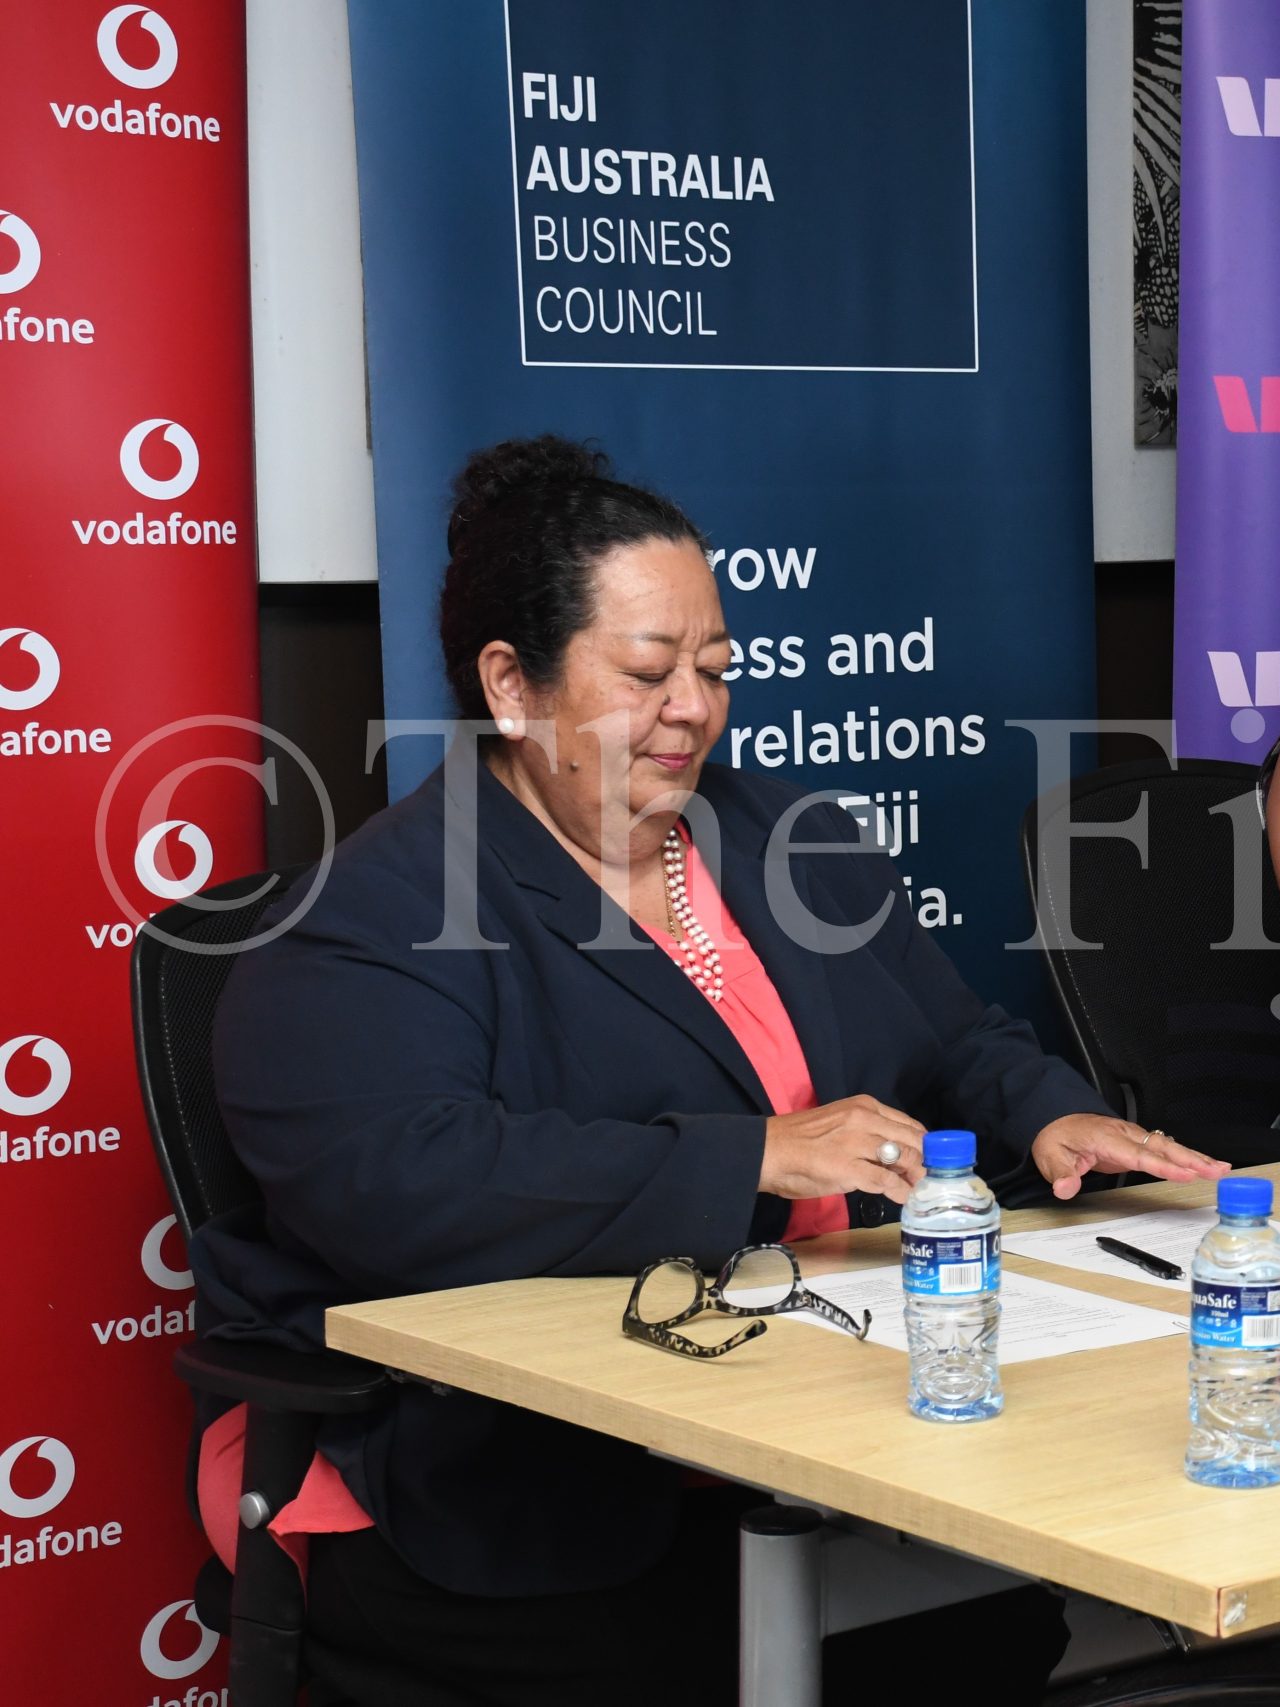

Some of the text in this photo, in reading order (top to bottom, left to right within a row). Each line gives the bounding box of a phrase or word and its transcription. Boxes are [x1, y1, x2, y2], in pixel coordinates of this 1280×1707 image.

[50, 99, 220, 142] vodafone
[523, 72, 597, 122] FIJI
[526, 145, 775, 202] AUSTRALIA
[533, 215, 732, 268] BUSINESS
[0, 307, 95, 344] fone
[536, 286, 717, 336] COUNCIL
[72, 512, 237, 545] vodafone
[827, 616, 935, 676] and
[0, 722, 112, 756] afone
[730, 706, 986, 769] relations
[85, 912, 156, 949] vo
